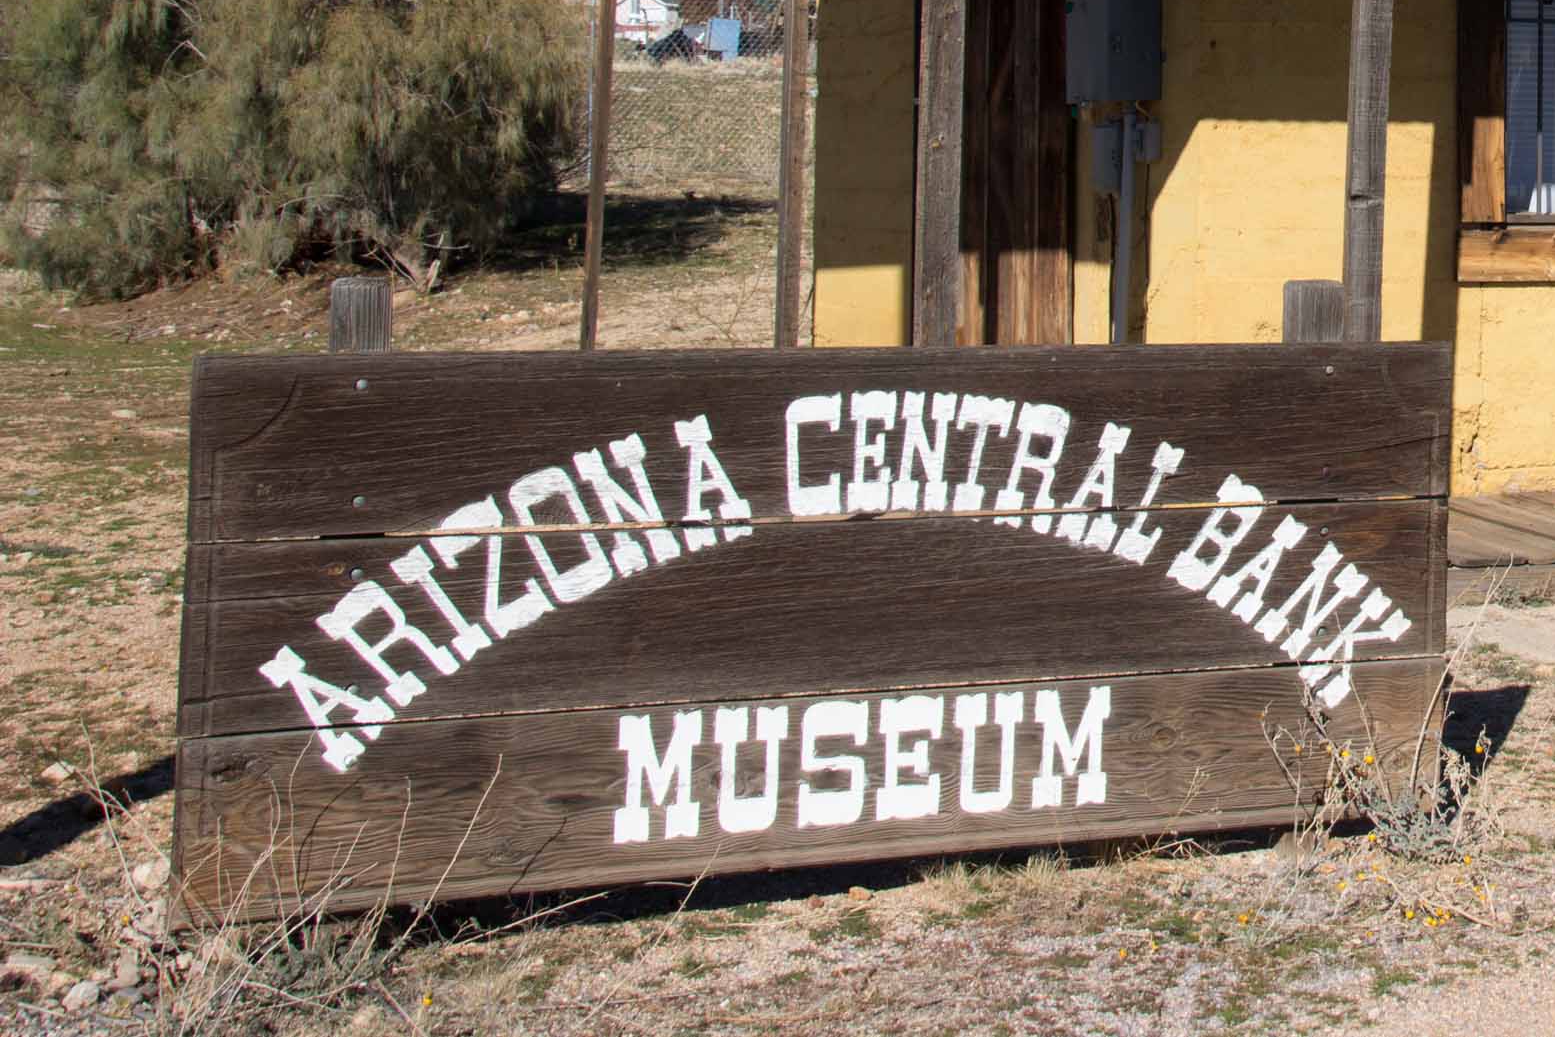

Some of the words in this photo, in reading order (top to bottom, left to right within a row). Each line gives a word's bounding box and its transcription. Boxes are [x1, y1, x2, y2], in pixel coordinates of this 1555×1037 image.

[258, 414, 754, 774] ARIZONA
[784, 390, 1187, 568] CENTRAL
[1166, 473, 1413, 710] BANK
[612, 685, 1113, 844] MUSEUM
